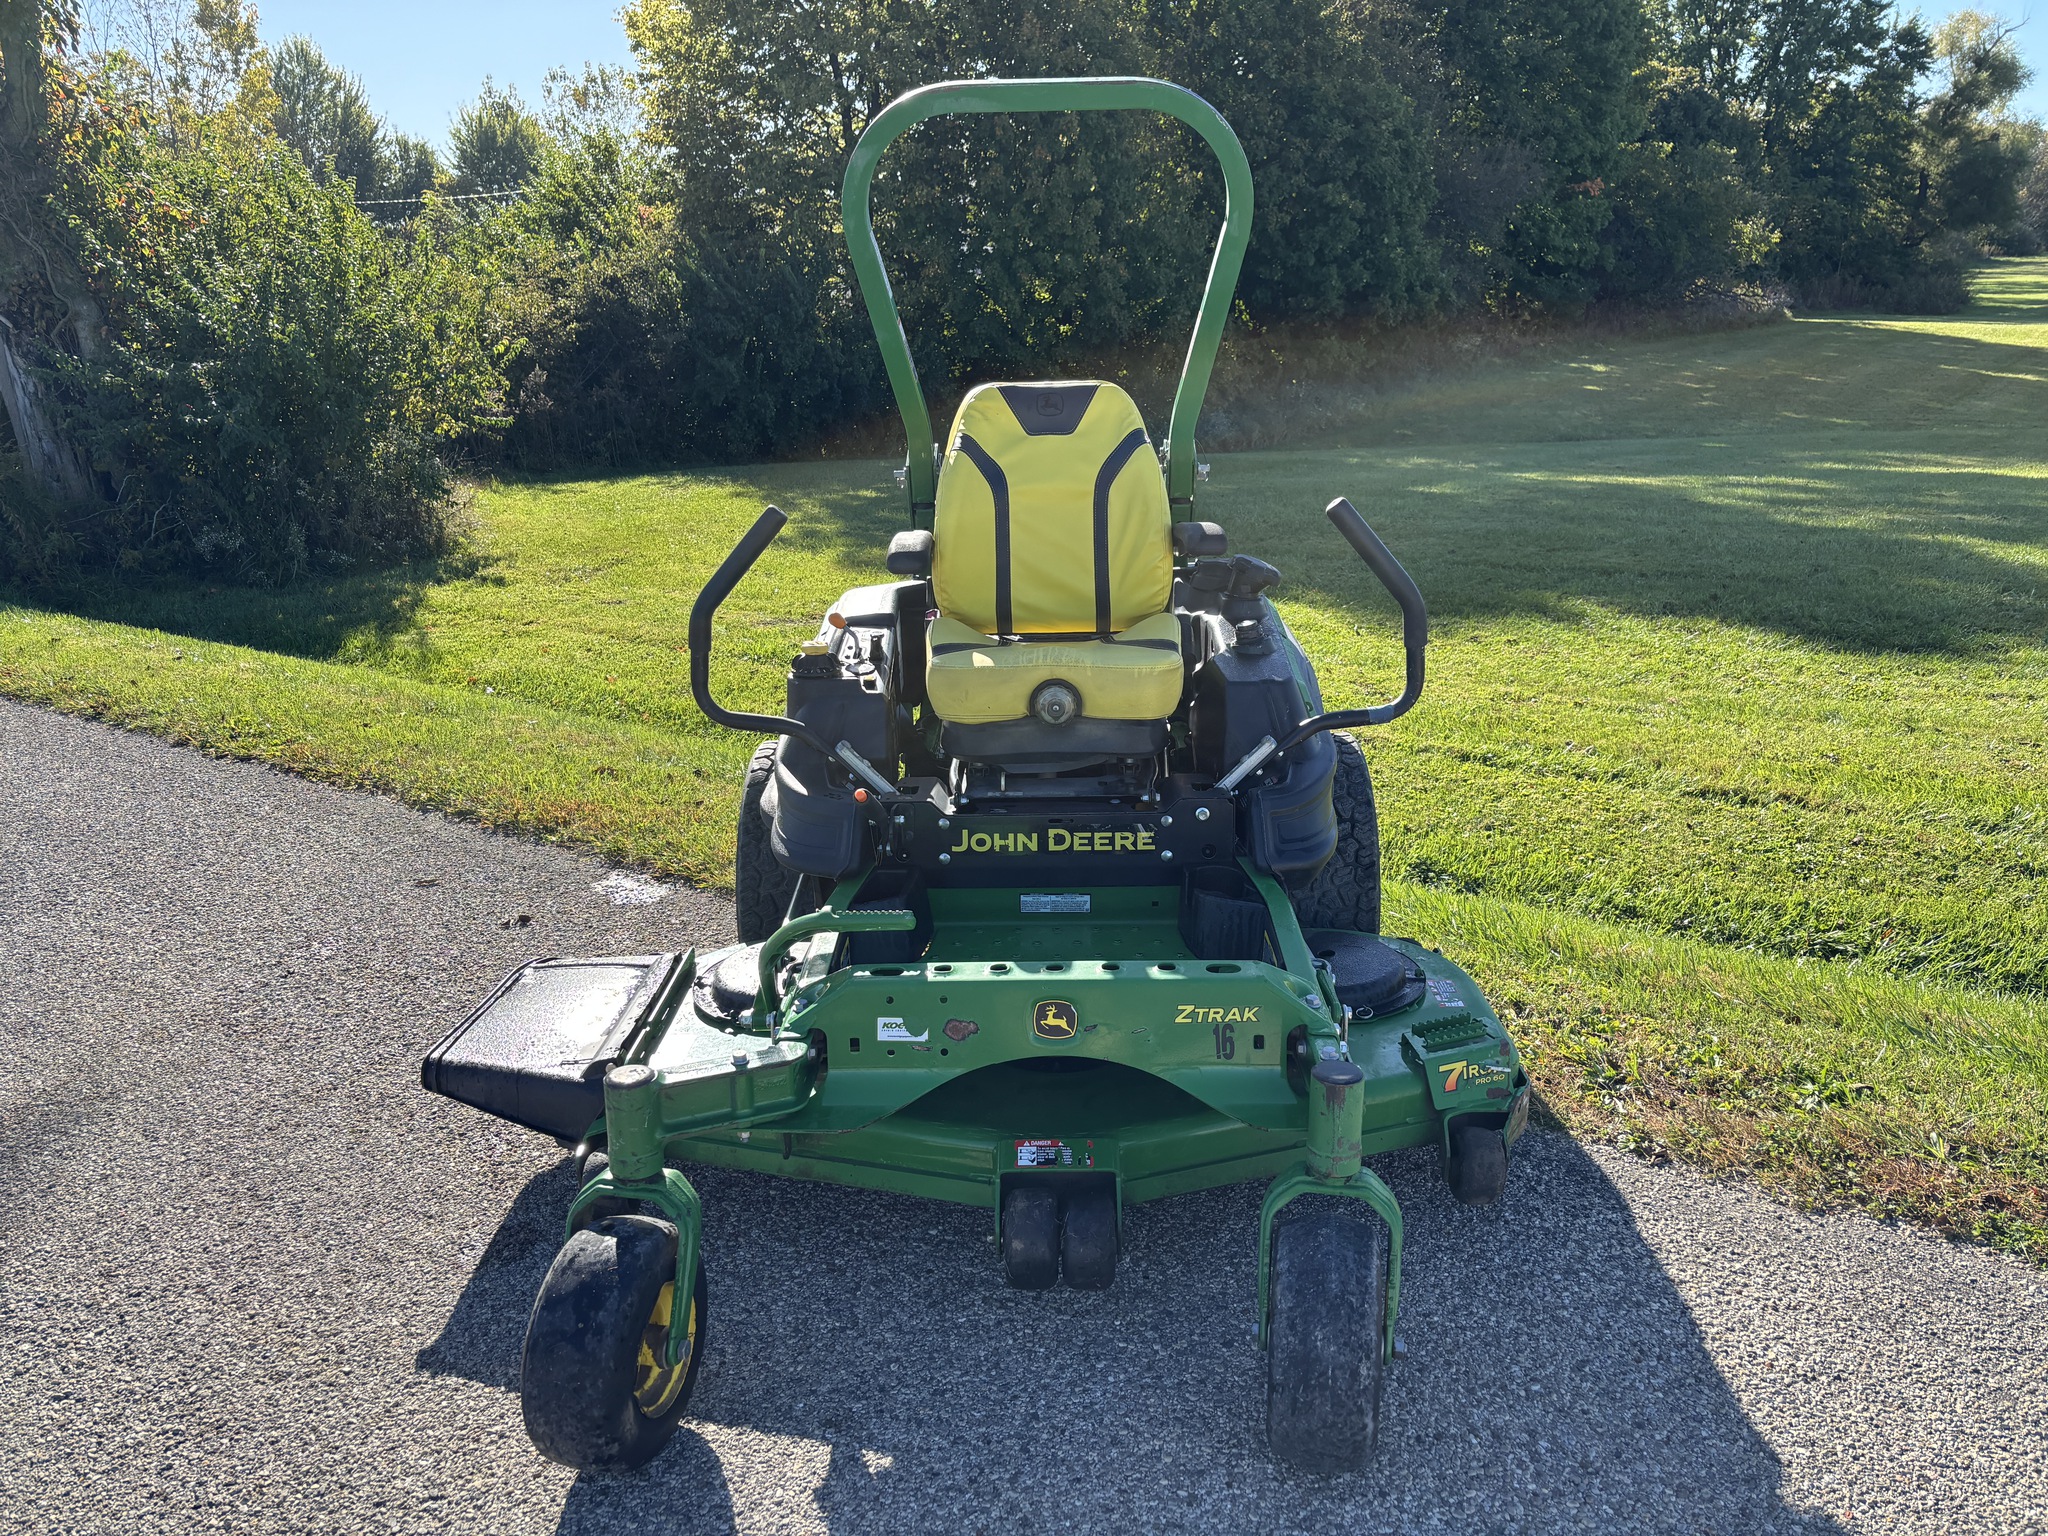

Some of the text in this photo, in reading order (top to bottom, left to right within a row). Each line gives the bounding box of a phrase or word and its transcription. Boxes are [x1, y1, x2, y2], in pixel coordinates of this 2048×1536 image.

[952, 828, 1156, 852] JOHN DEERE
[1174, 1004, 1261, 1023] ZTRAK
[1213, 1023, 1235, 1060] 16
[1475, 1073, 1505, 1086] PRO 60
